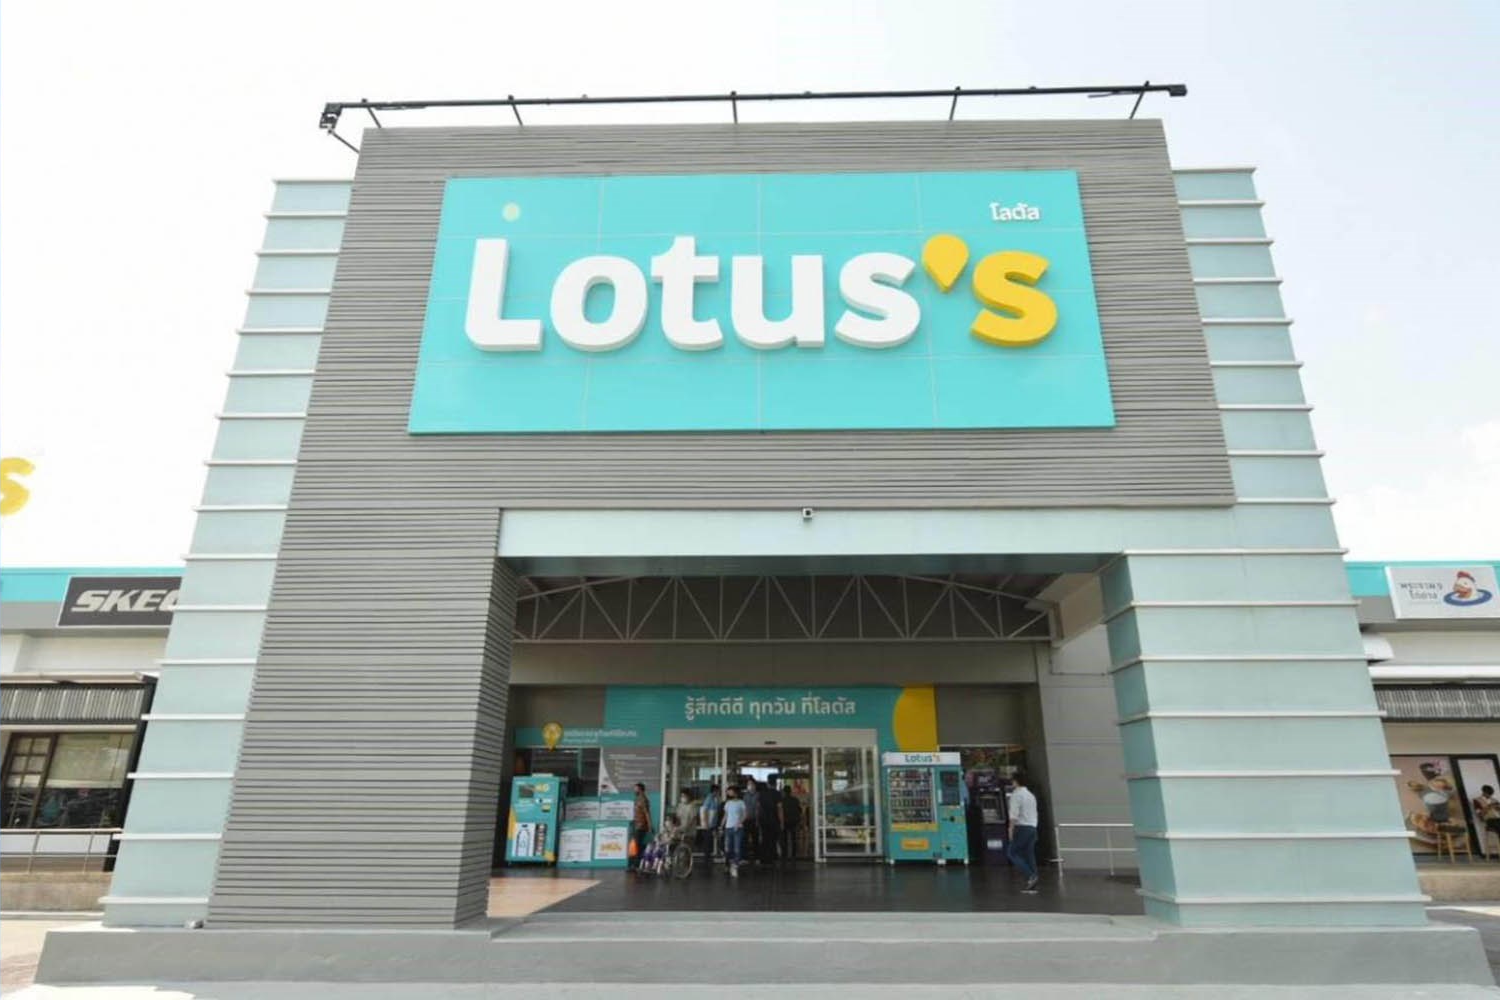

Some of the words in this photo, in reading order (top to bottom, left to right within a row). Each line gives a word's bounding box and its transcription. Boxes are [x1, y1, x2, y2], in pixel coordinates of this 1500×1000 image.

[989, 202, 1041, 221] โลตัส
[465, 233, 1059, 352] Lotus's
[749, 696, 795, 720] ทุกวัน
